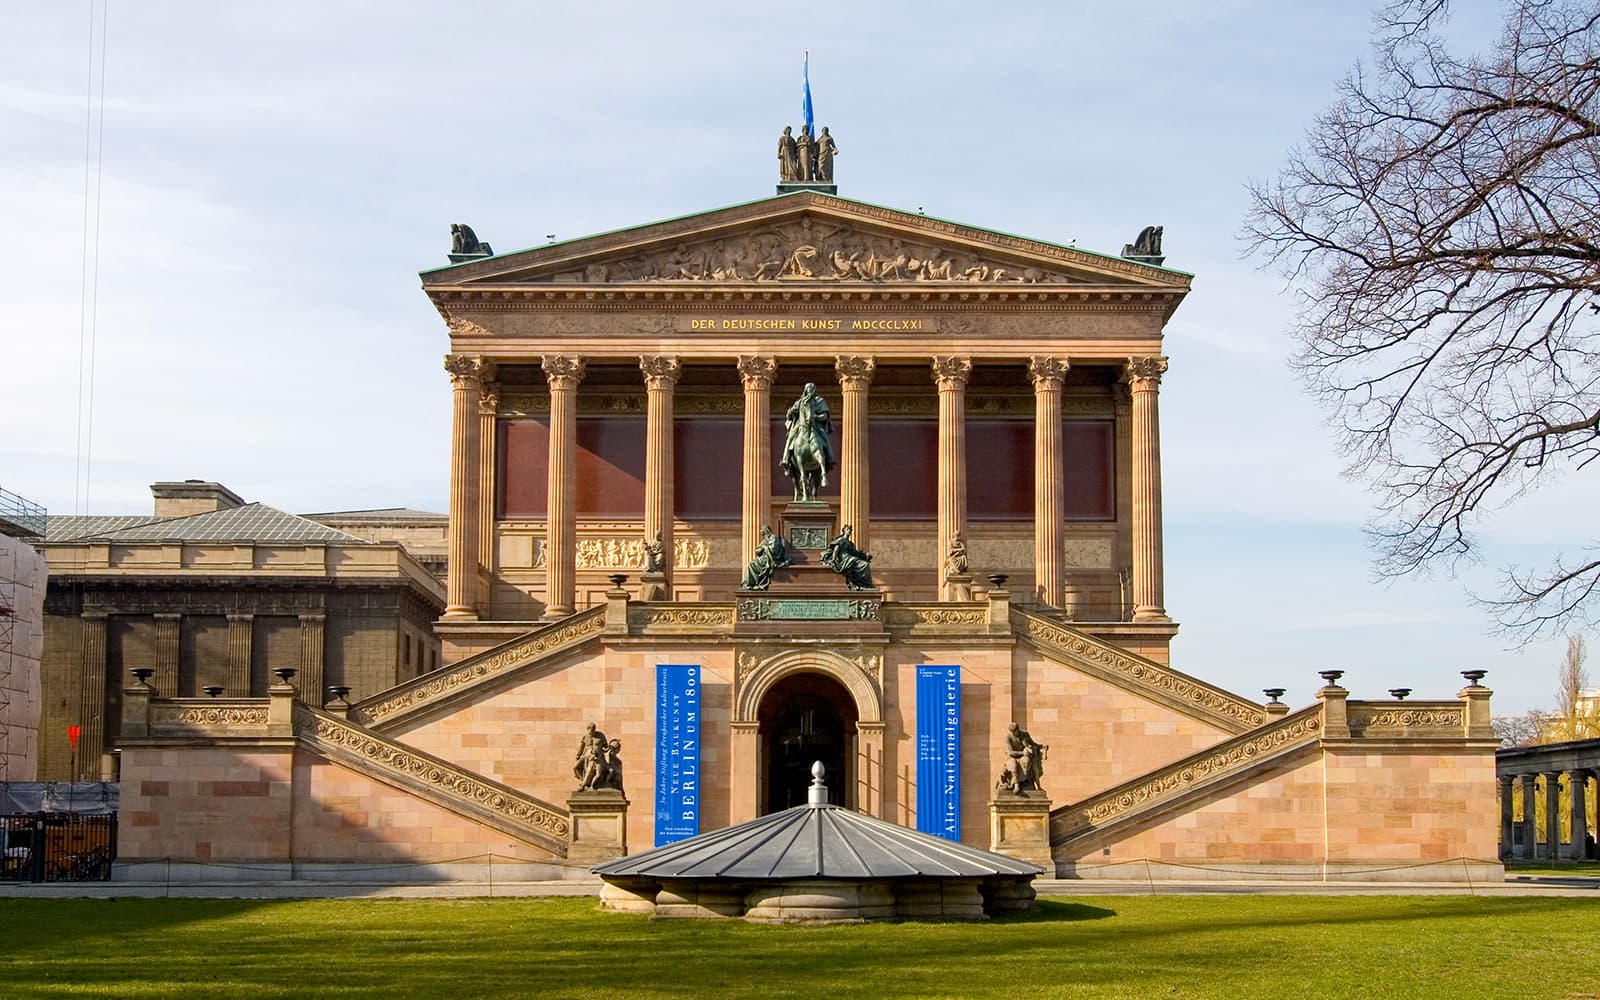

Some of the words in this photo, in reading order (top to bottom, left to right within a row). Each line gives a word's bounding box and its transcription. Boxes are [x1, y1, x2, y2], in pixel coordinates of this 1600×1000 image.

[691, 319, 716, 330] DER
[722, 319, 796, 330] DEUTSCHEN
[801, 319, 842, 331] KUNST
[851, 319, 922, 331] MDCCCLXXI
[685, 668, 697, 704] 1800
[686, 712, 696, 733] UM
[944, 669, 959, 795] Nationalgalerie
[682, 740, 696, 820] BERLIN
[944, 801, 956, 833] Alte
